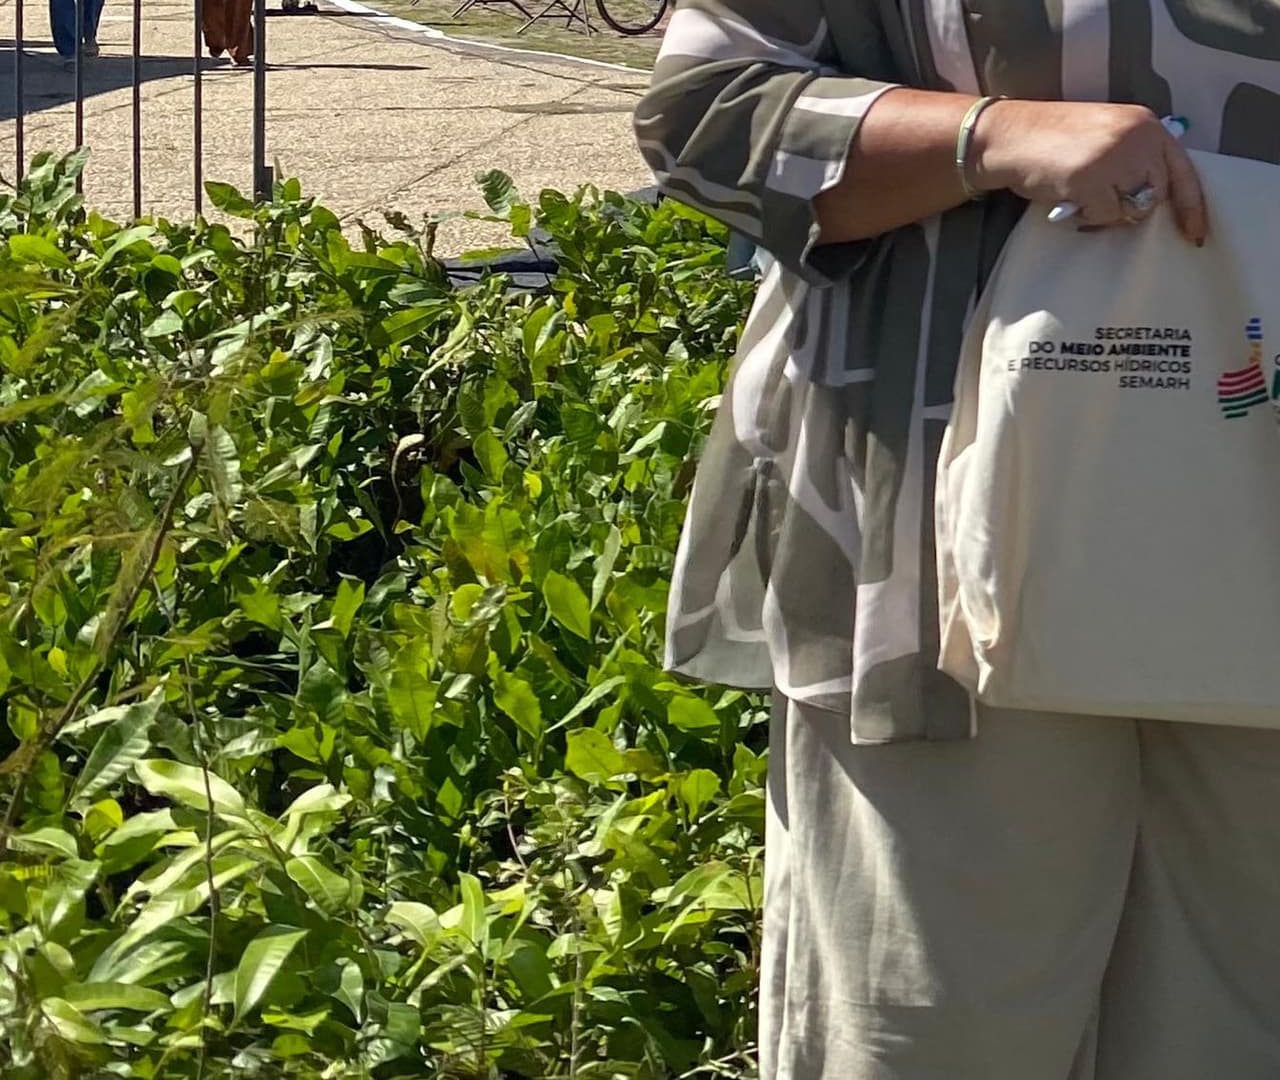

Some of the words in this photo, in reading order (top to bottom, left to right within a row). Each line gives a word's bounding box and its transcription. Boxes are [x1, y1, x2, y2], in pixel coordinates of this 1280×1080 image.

[1095, 327, 1192, 341] SECRETARIA
[1029, 341, 1055, 354] DO
[1060, 342, 1104, 356] MEIO
[1107, 343, 1191, 357] AMBIENTE
[1007, 359, 1016, 371] E
[1021, 357, 1111, 372] RECURSOS
[1114, 357, 1191, 374] HÍDRICOS
[1119, 375, 1190, 390] SEMARH
